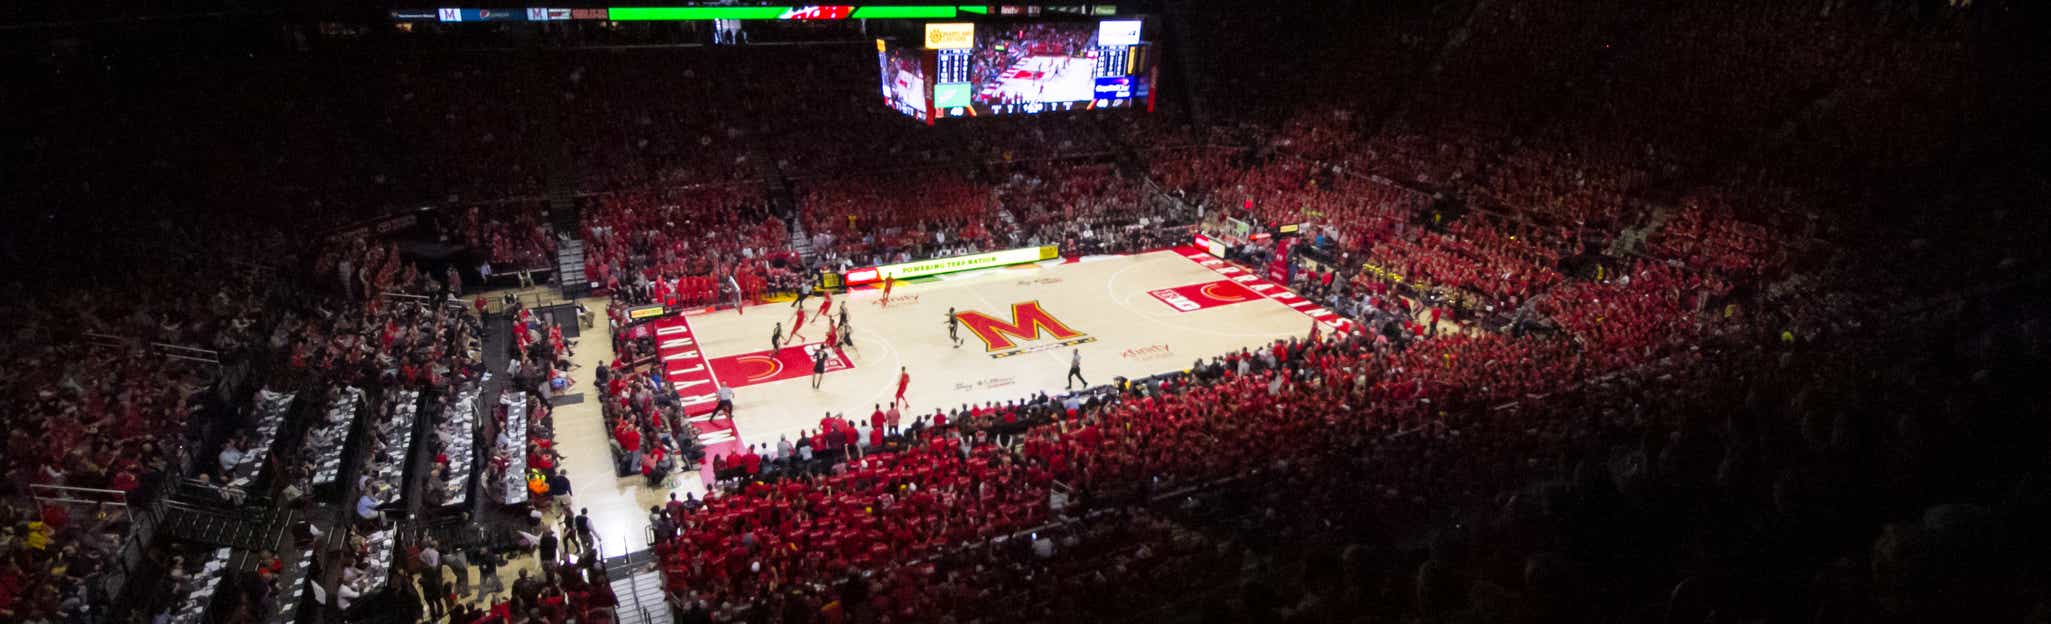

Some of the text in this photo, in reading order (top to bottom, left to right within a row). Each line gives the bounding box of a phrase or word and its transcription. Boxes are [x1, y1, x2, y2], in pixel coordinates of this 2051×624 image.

[902, 256, 997, 273] POWERING TERP NATION
[1187, 252, 1353, 338] TERRAPINS
[955, 300, 1087, 352] M
